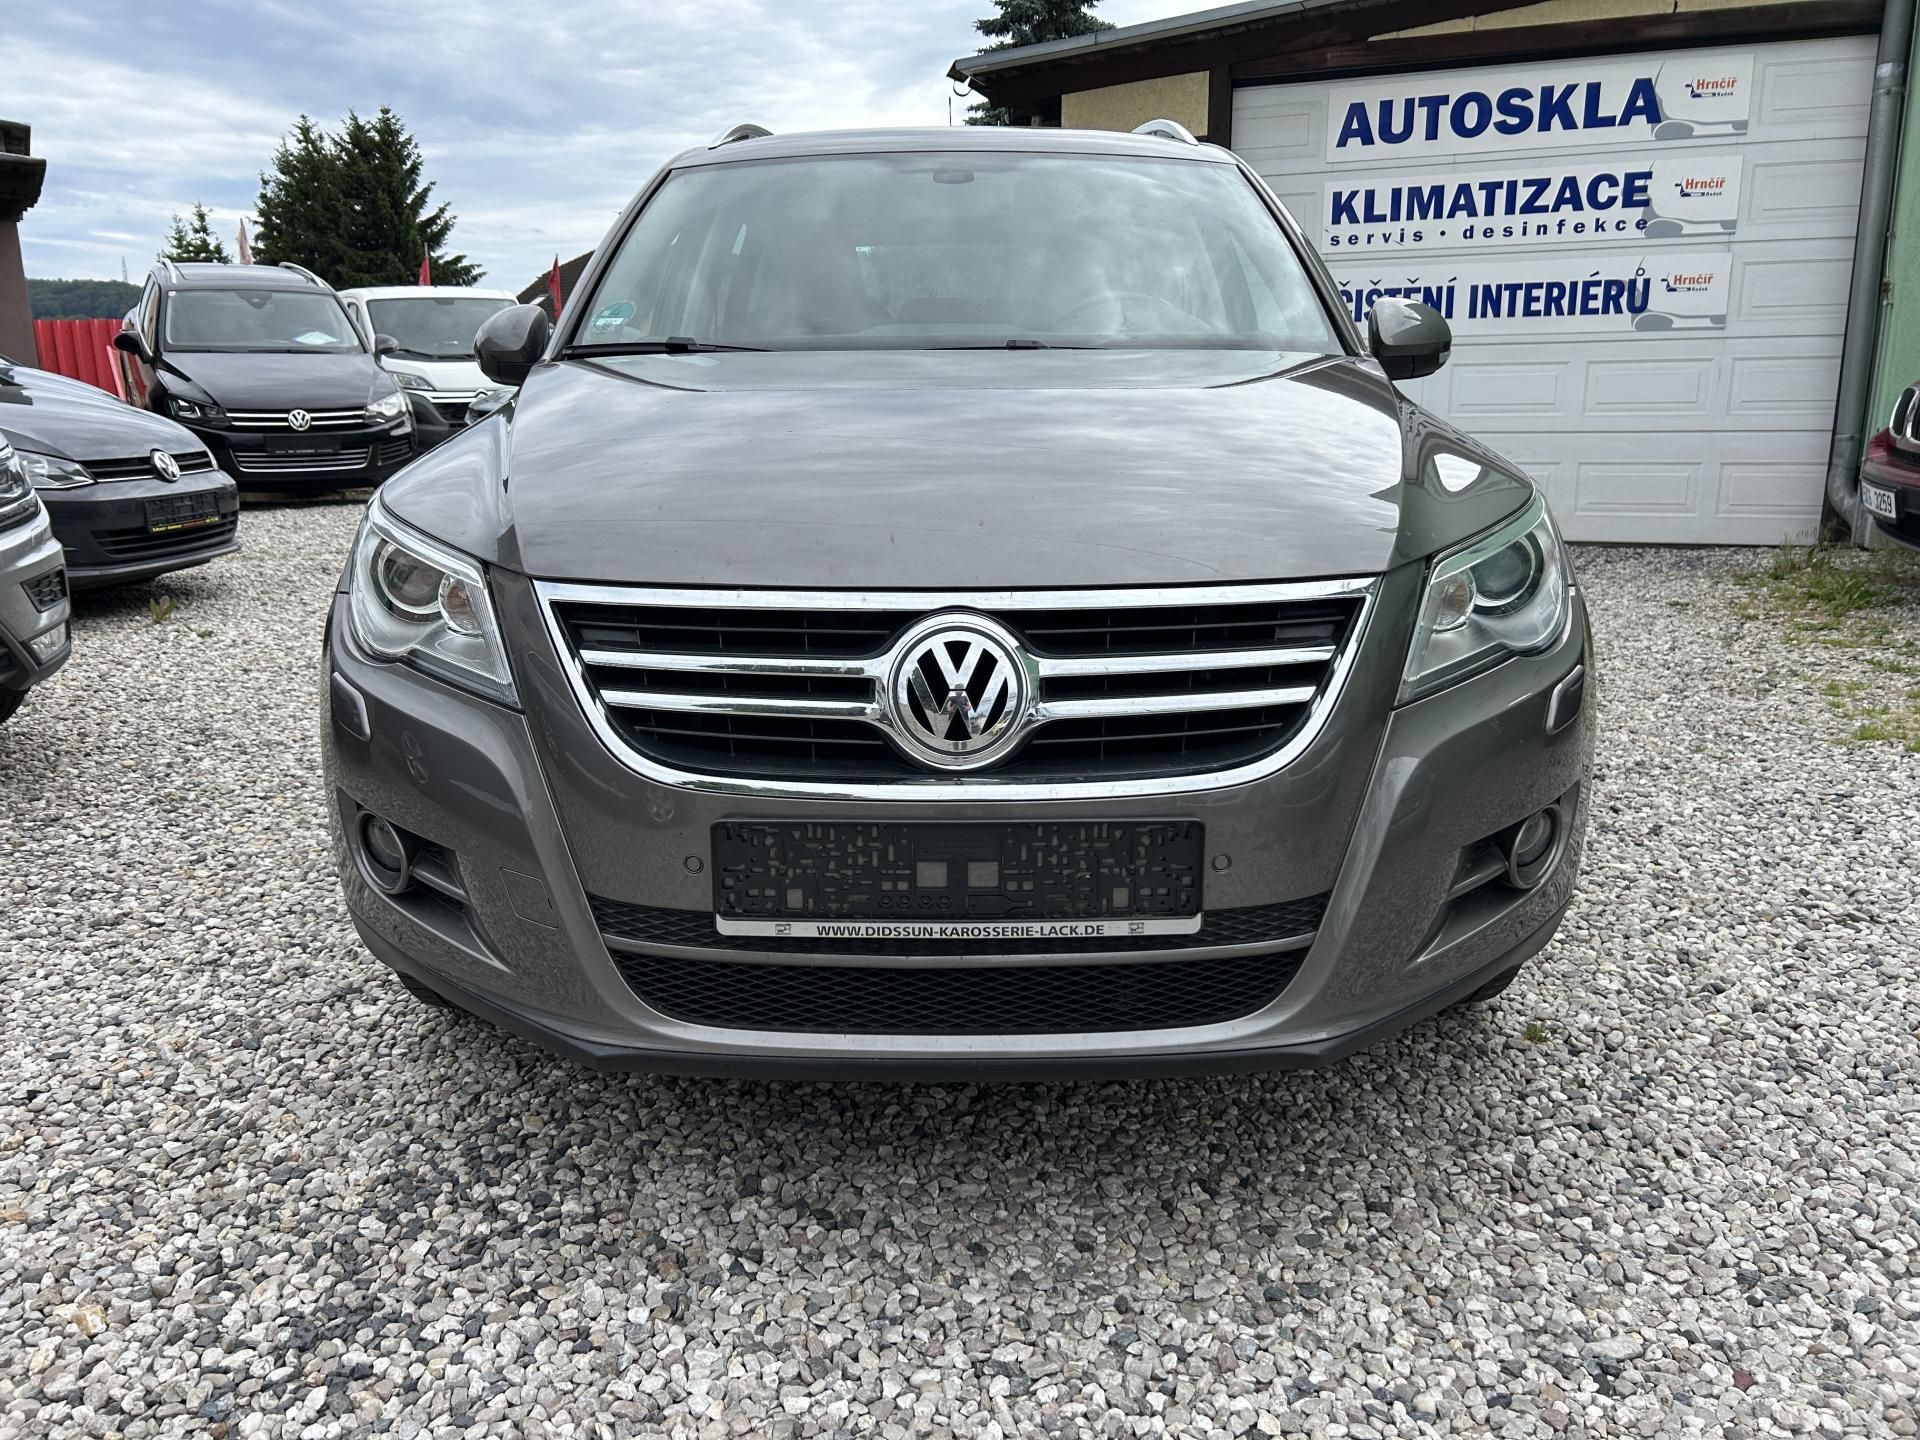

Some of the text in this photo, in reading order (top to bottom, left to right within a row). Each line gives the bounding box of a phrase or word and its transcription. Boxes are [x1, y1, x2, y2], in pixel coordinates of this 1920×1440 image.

[1336, 77, 1664, 148] AUTOSKLA
[1330, 170, 1654, 225] KLIMATIZACE
[1329, 216, 1649, 247] servis desinfekce
[1468, 266, 1652, 319] INTERIÉRŮ
[897, 630, 1018, 752] VW
[816, 924, 1105, 938] WWW.DIDSSUN-KAROSSERIE-LACK.DE
